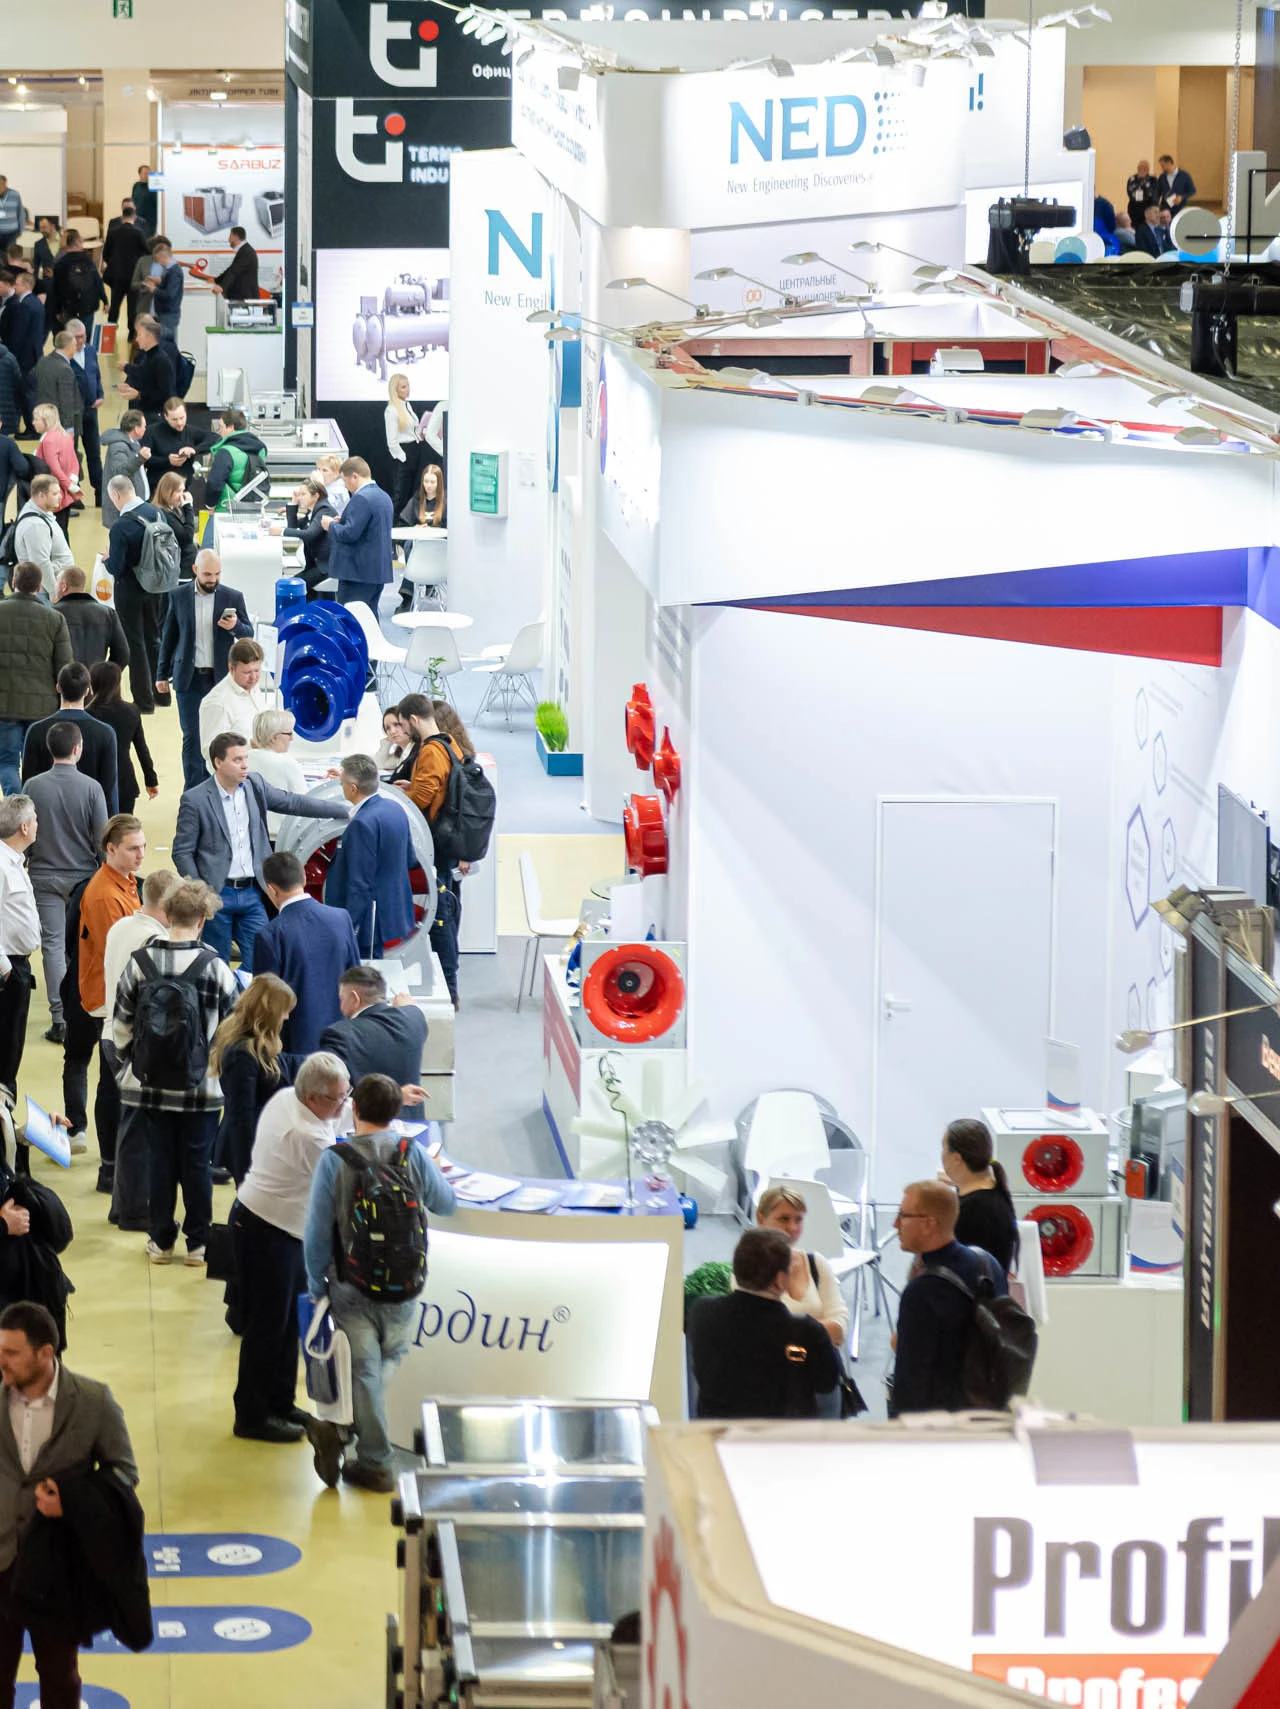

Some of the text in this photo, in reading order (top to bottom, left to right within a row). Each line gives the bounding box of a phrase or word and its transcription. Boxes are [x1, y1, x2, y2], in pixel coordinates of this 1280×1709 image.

[728, 94, 867, 164] NED
[407, 145, 464, 163] TERM
[217, 159, 281, 170] SARBUZ
[727, 171, 866, 195] New Engineering Discoveries
[779, 273, 838, 291] ЦЕНТРАЛЬНЫЕ
[484, 290, 511, 307] New
